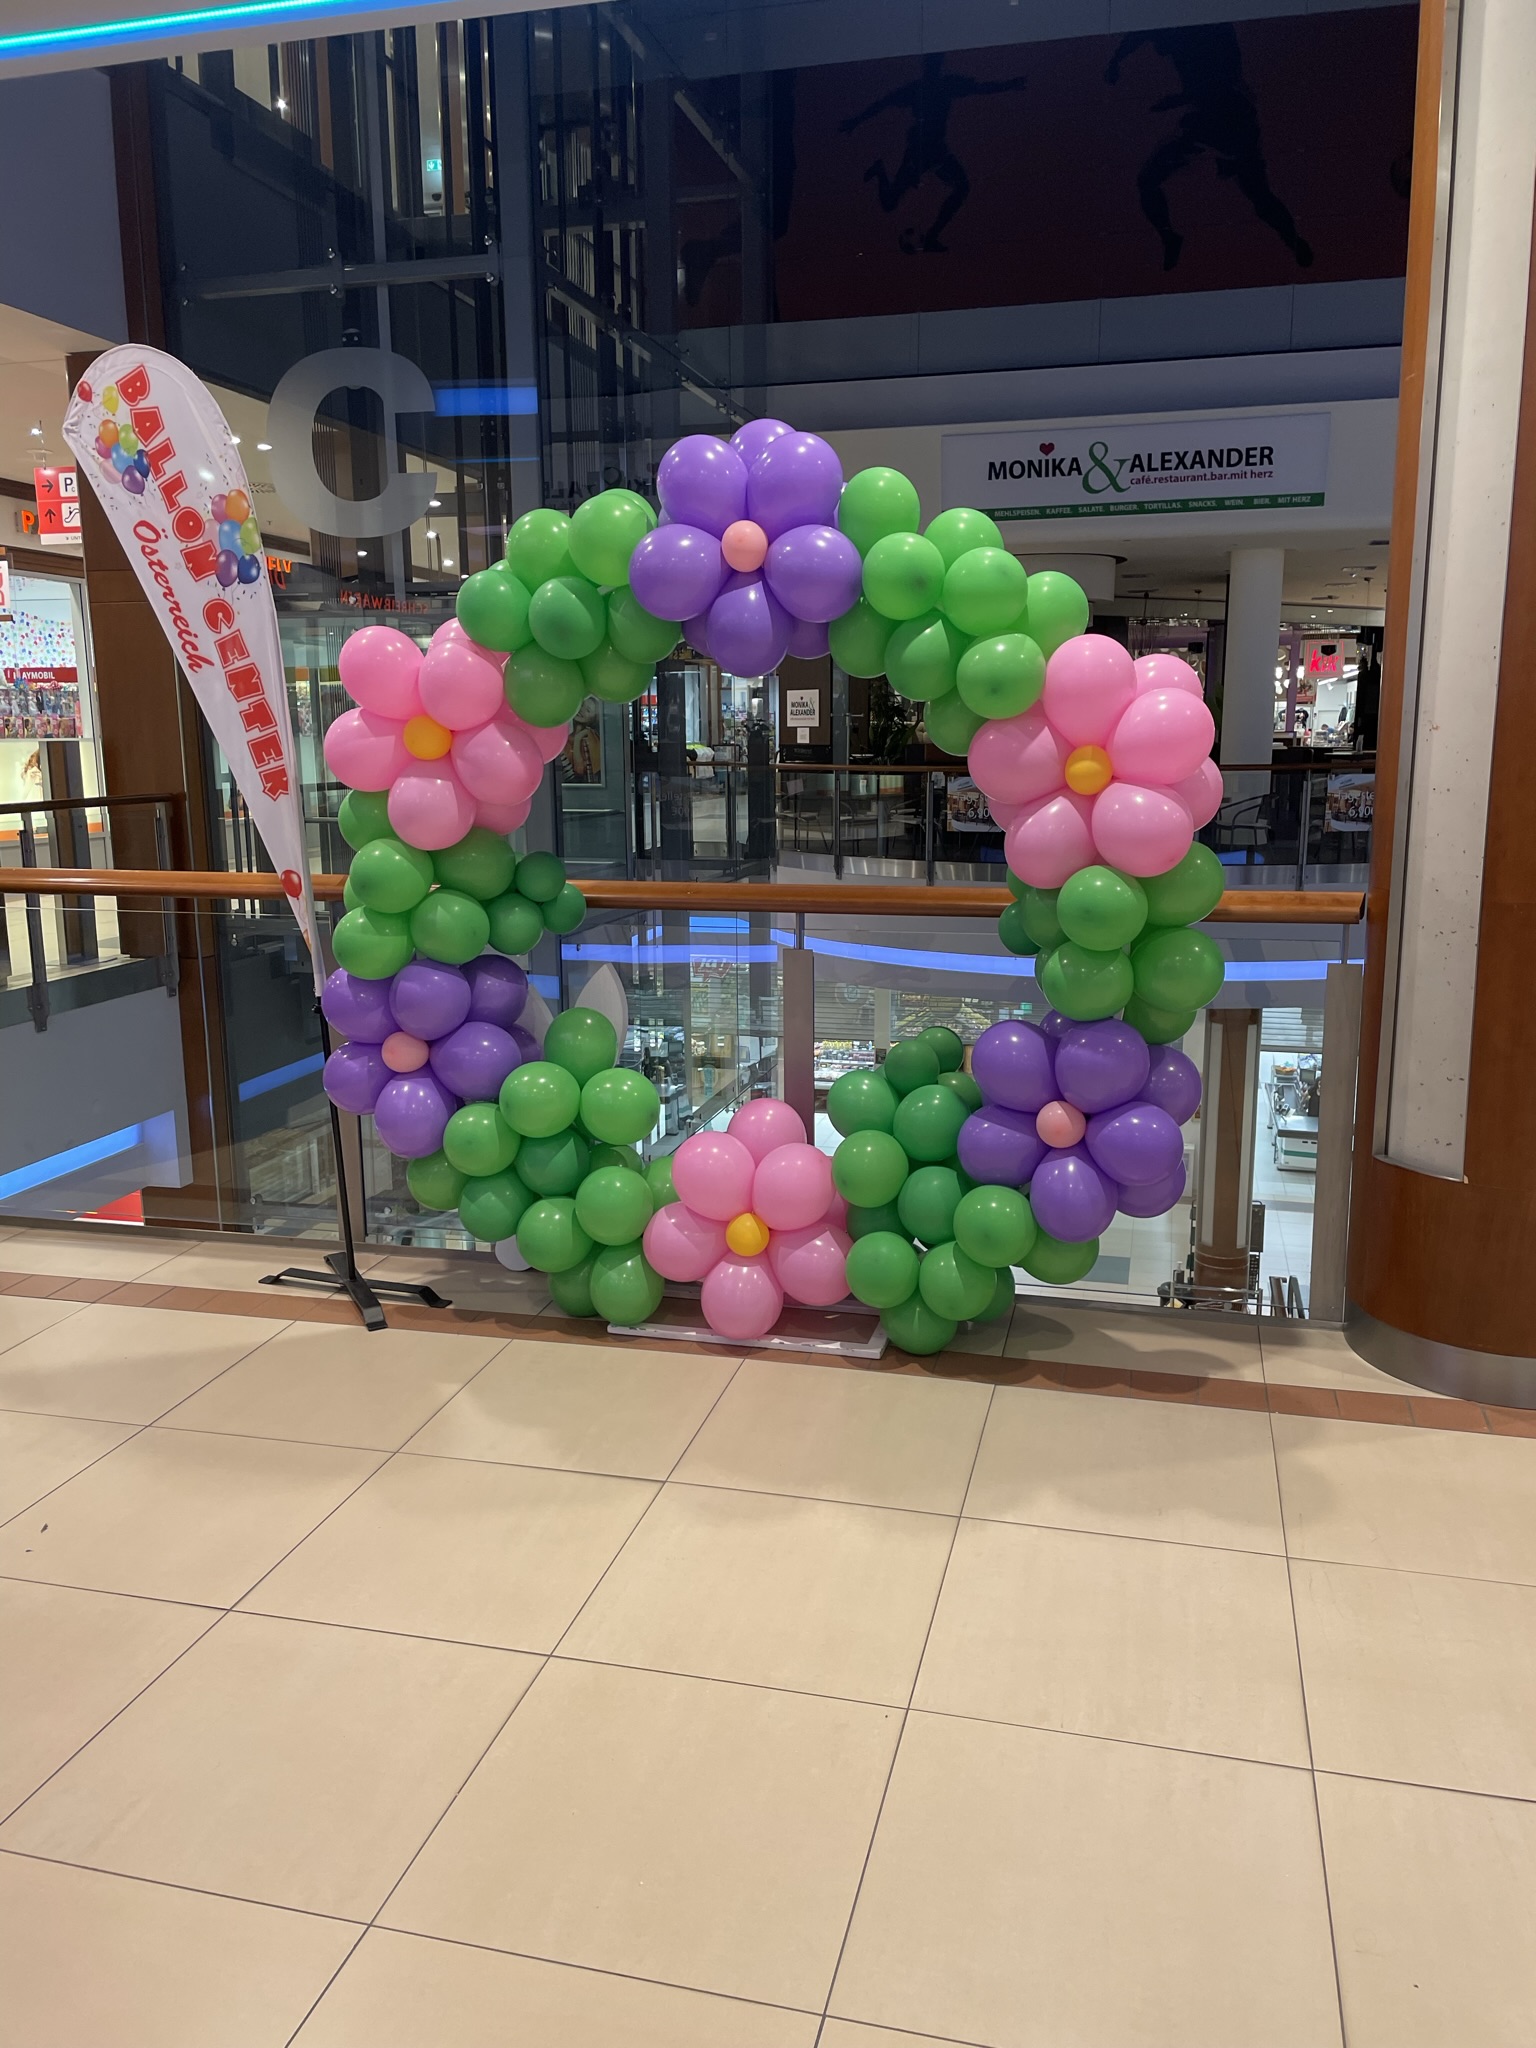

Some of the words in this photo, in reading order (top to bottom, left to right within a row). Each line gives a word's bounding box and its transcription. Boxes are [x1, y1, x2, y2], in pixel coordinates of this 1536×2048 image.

[987, 456, 1083, 481] MONIKA
[1082, 441, 1131, 494] &
[1129, 445, 1274, 473] ALEXANDER
[1250, 469, 1273, 480] herz
[1277, 496, 1291, 504] MIT
[1292, 495, 1311, 503] HERZ
[115, 363, 219, 583] BALLON
[202, 598, 289, 802] CENTER
[133, 519, 215, 674] Österreich
[13, 671, 55, 680] AYMOBIL
[790, 708, 816, 716] ALEXANDER
